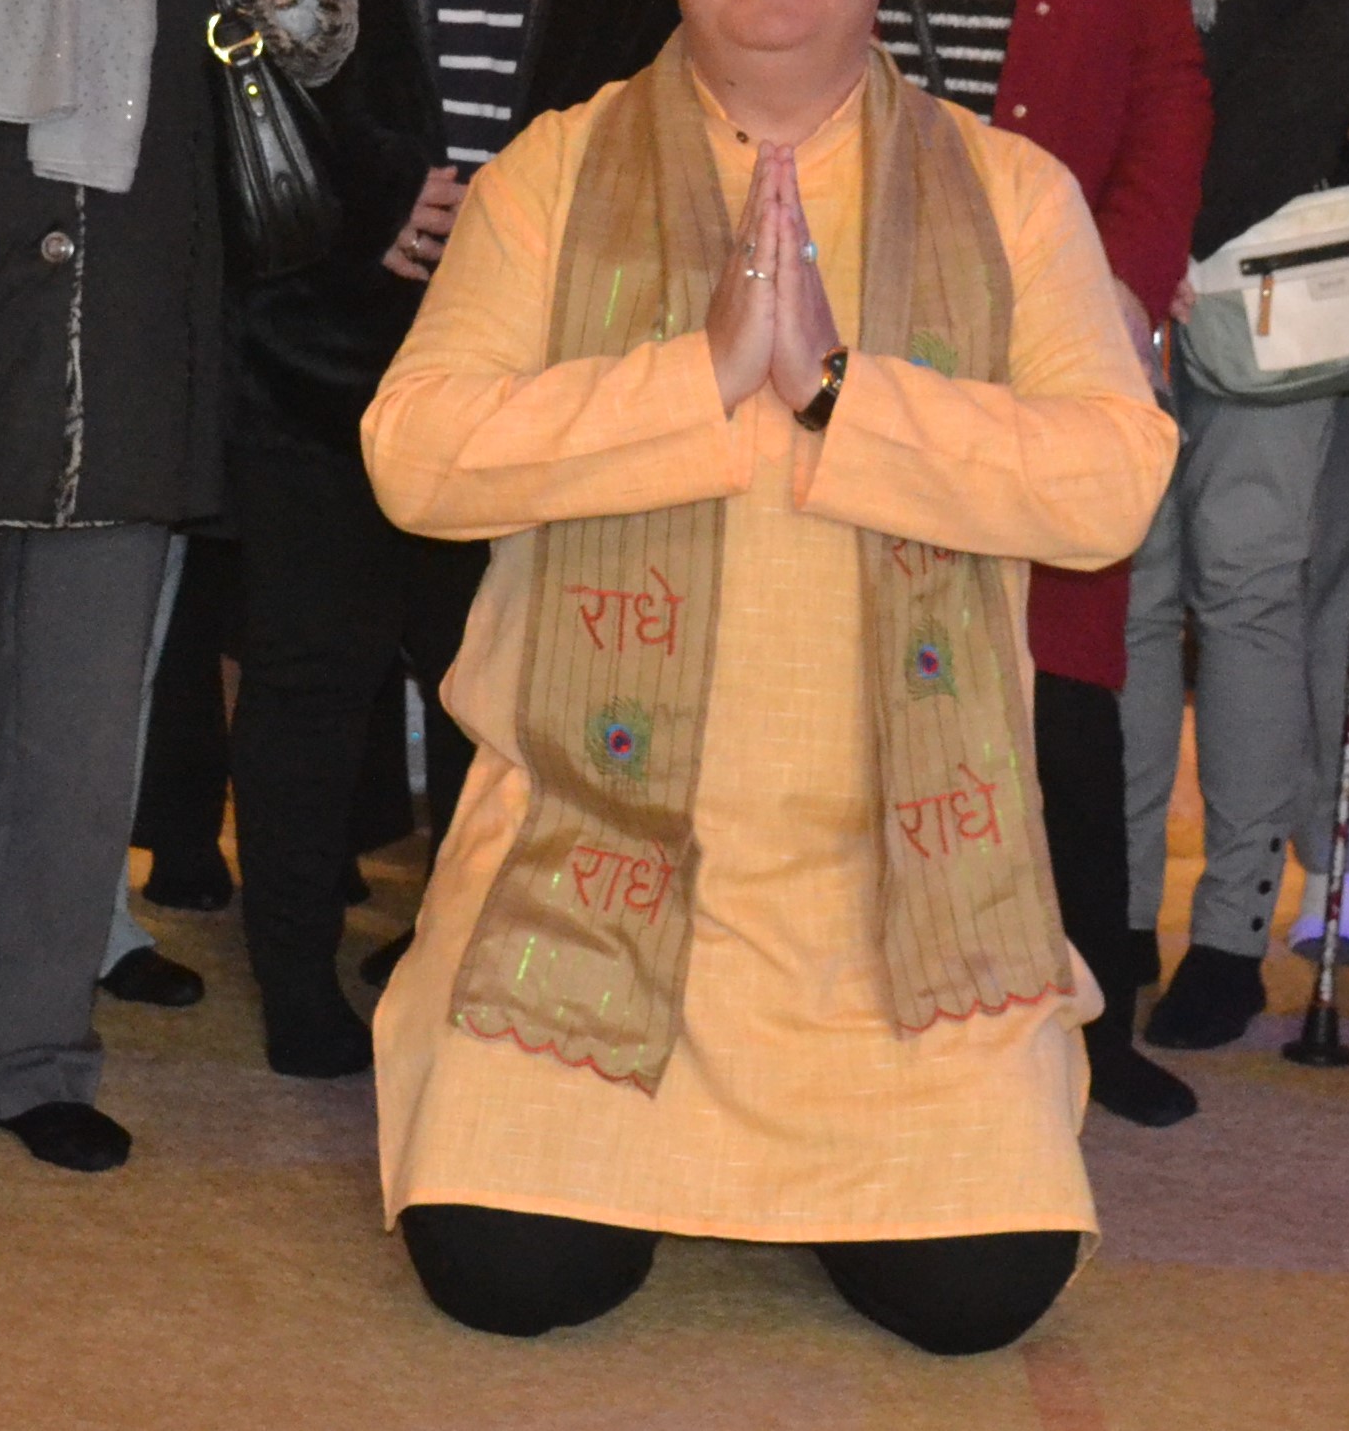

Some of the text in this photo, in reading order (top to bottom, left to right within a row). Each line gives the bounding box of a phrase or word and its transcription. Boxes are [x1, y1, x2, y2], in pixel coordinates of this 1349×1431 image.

[564, 566, 683, 655] राधे
[895, 763, 1001, 859] राधे
[572, 837, 672, 925] राधे
